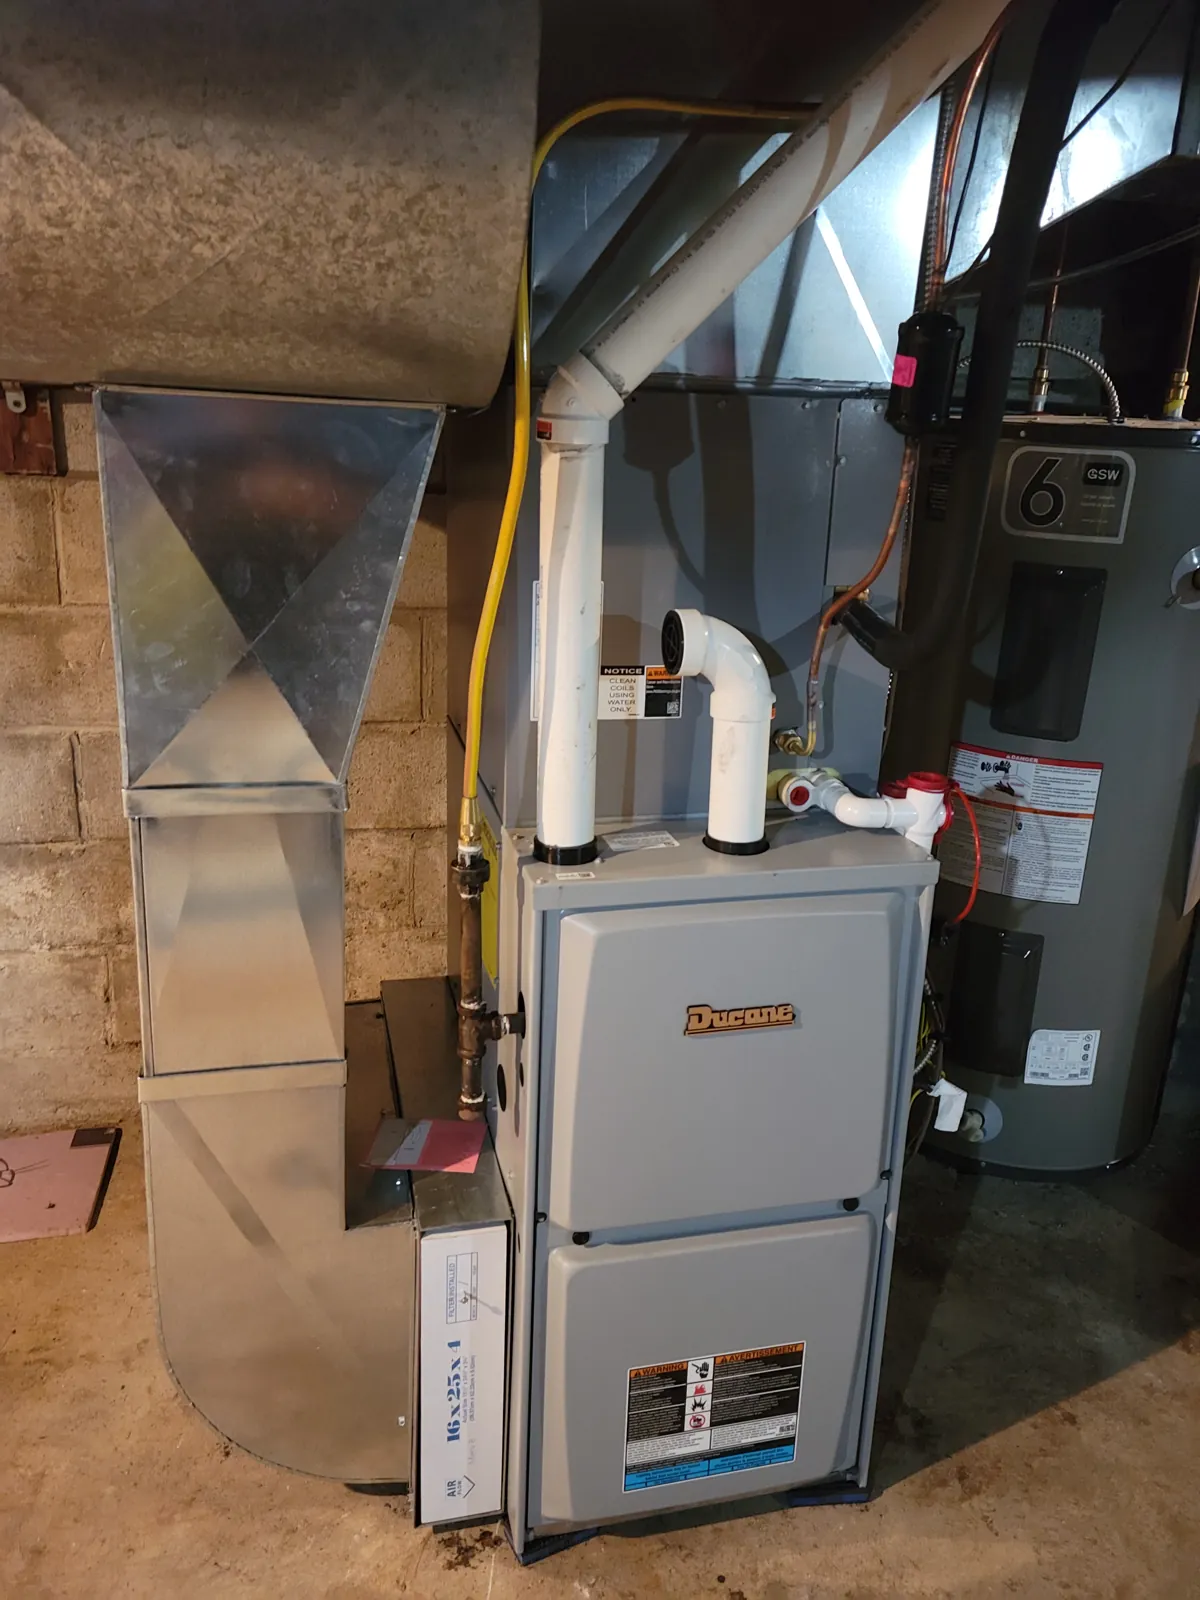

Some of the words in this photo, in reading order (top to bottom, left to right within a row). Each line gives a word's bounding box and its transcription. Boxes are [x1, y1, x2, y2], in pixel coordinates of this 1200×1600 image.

[1087, 468, 1120, 481] GSW
[1019, 456, 1066, 528] 6
[1011, 754, 1039, 763] DANGER
[686, 1004, 794, 1031] Ducane
[448, 1262, 456, 1296] INSTALLED
[448, 1297, 456, 1318] FILTER
[446, 1340, 461, 1353] 4
[729, 1344, 798, 1361] AVERTISSEMENT
[450, 1355, 461, 1371] x
[642, 1363, 684, 1375] WARNING
[446, 1373, 461, 1401] 25
[450, 1403, 461, 1418] x
[446, 1419, 461, 1443] 16
[447, 1480, 457, 1497] AIR
